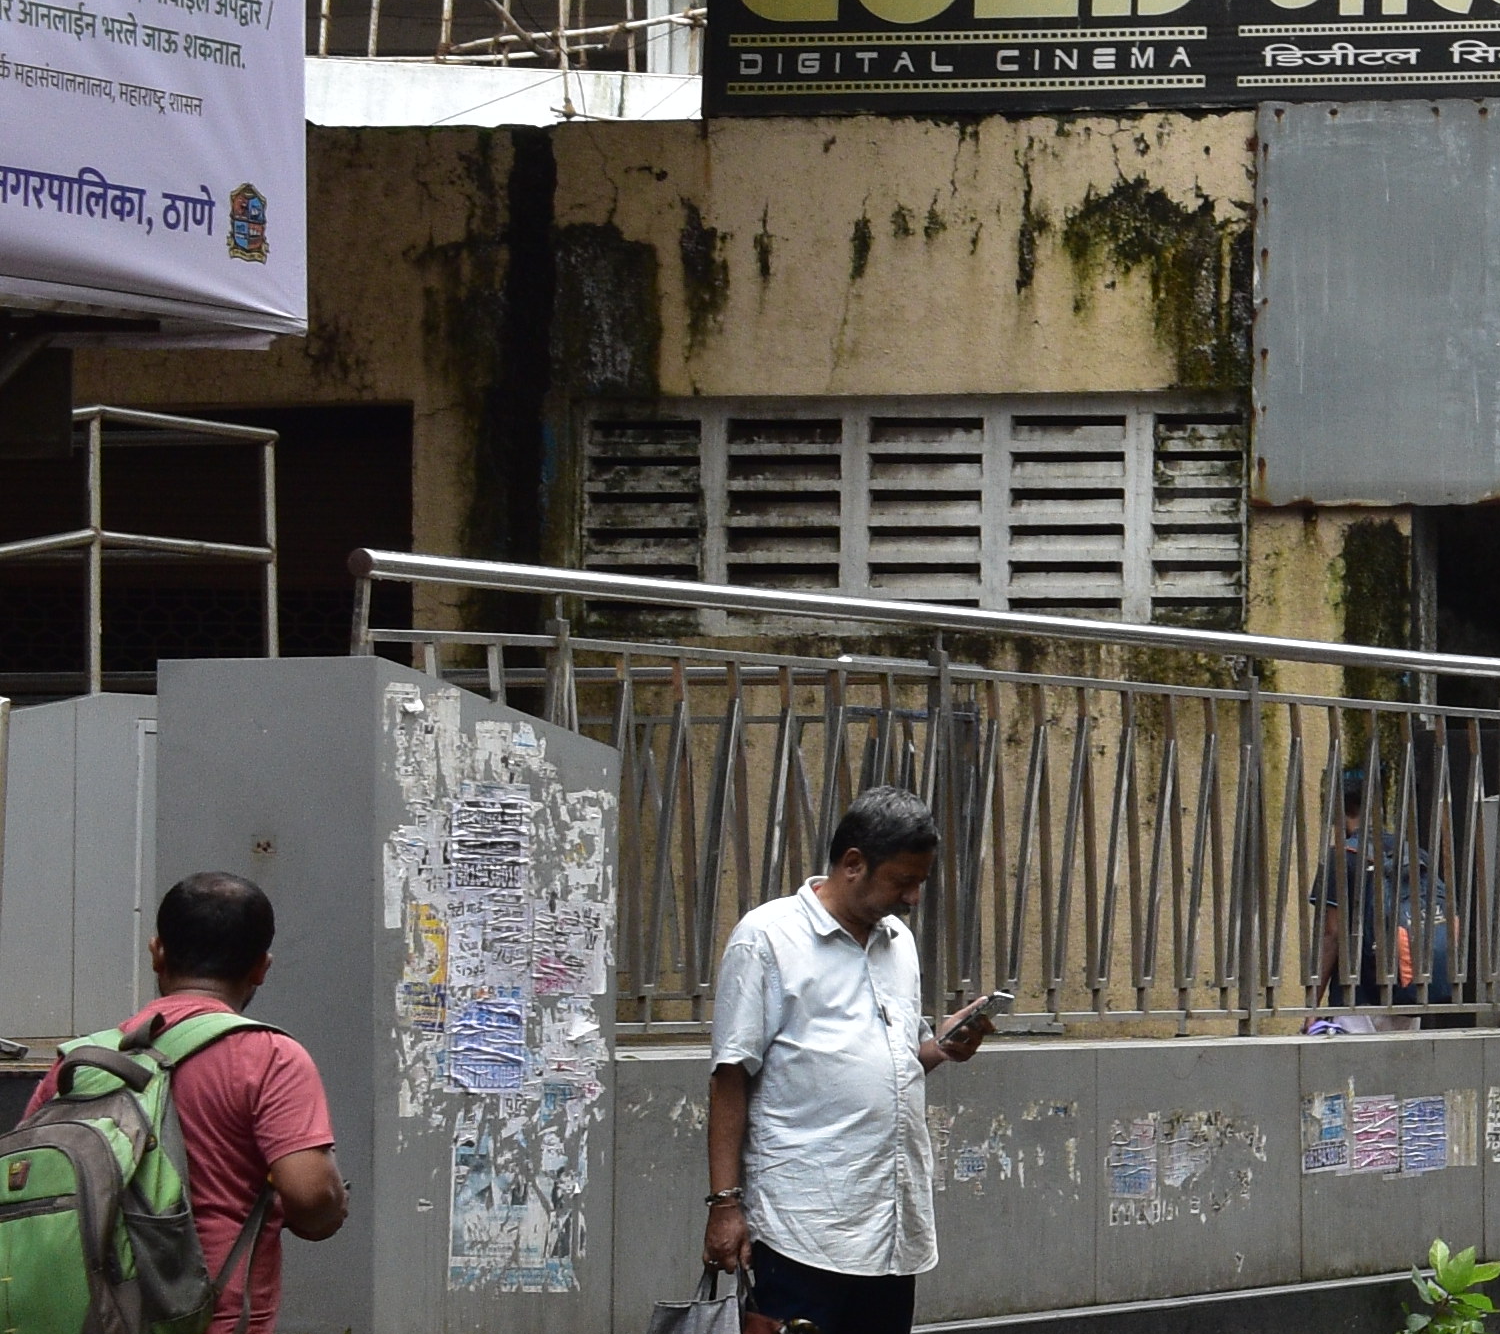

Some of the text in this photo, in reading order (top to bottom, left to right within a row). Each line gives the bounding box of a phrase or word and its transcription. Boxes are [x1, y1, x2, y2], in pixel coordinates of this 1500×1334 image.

[738, 45, 1192, 76] DIGITAL CINEMA
[1262, 41, 1421, 69] डिजीटल
[162, 184, 216, 236] ठाणे
